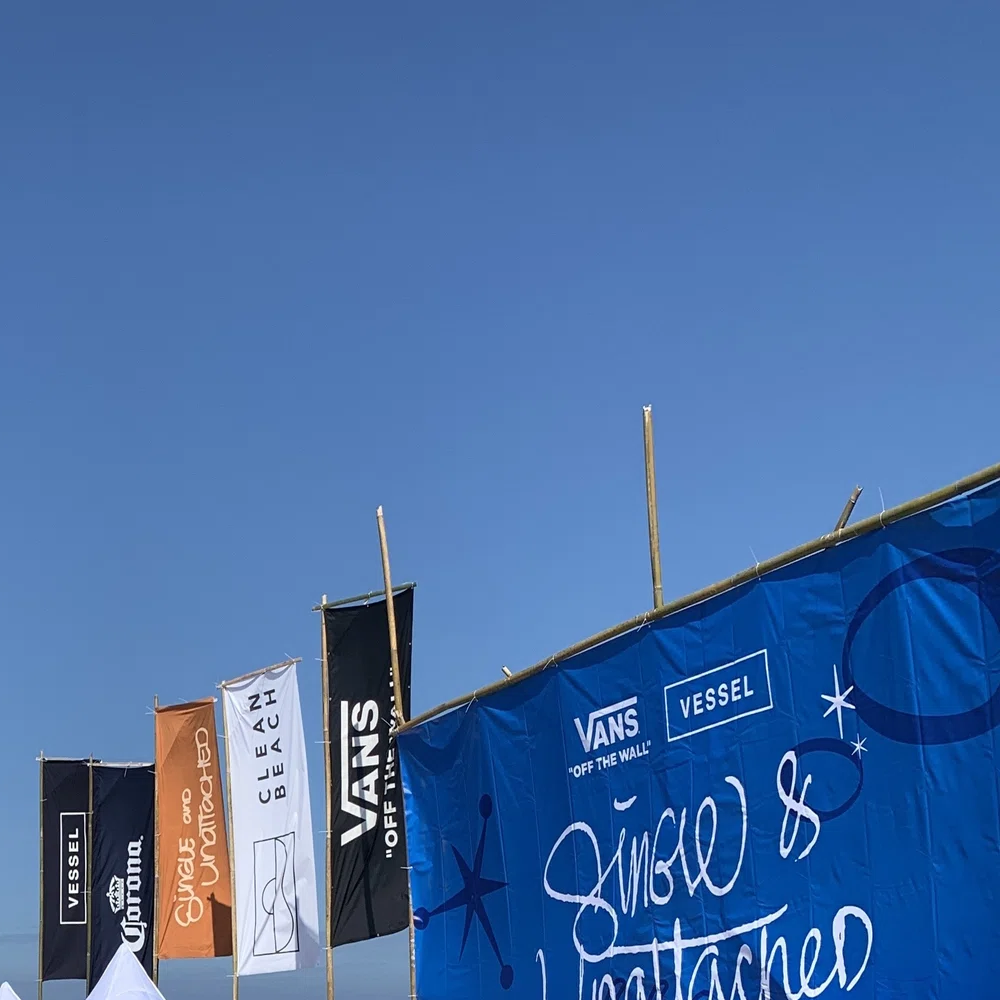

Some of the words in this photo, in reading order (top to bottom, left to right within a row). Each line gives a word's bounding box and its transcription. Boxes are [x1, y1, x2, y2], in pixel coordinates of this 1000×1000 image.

[574, 696, 641, 753] VANS
[680, 675, 754, 719] VESSEL
[247, 692, 271, 804] CLEAN
[263, 688, 286, 800] BEACH
[341, 700, 379, 847] VANS
[568, 761, 594, 778] "OFF
[595, 752, 618, 771] THE
[618, 740, 652, 763] WALL"
[384, 801, 398, 858] "OFF
[68, 827, 80, 909] VESSEL
